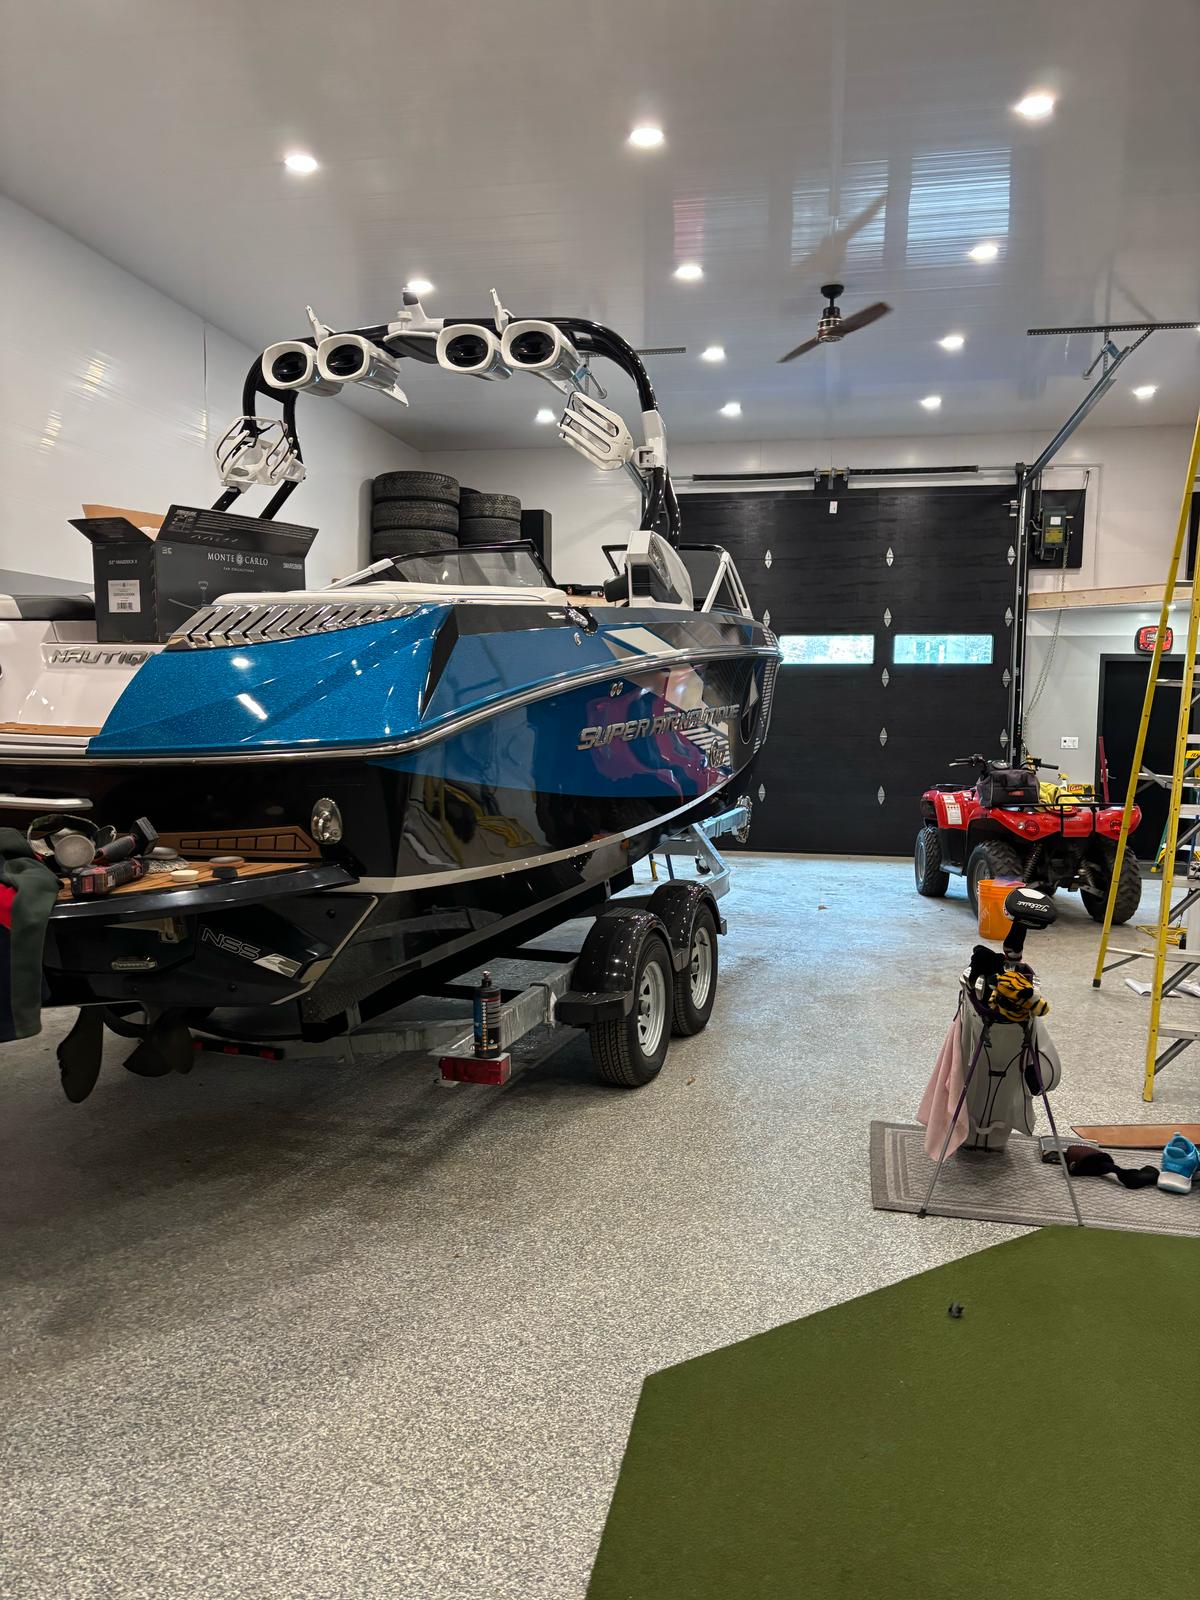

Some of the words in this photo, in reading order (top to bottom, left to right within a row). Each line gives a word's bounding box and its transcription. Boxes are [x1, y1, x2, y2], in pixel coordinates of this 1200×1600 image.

[207, 552, 235, 563] MONTE
[244, 556, 269, 566] CARLO
[51, 649, 155, 666] NAUTIQ
[576, 717, 650, 750] SUPER
[201, 928, 261, 960] NSS
